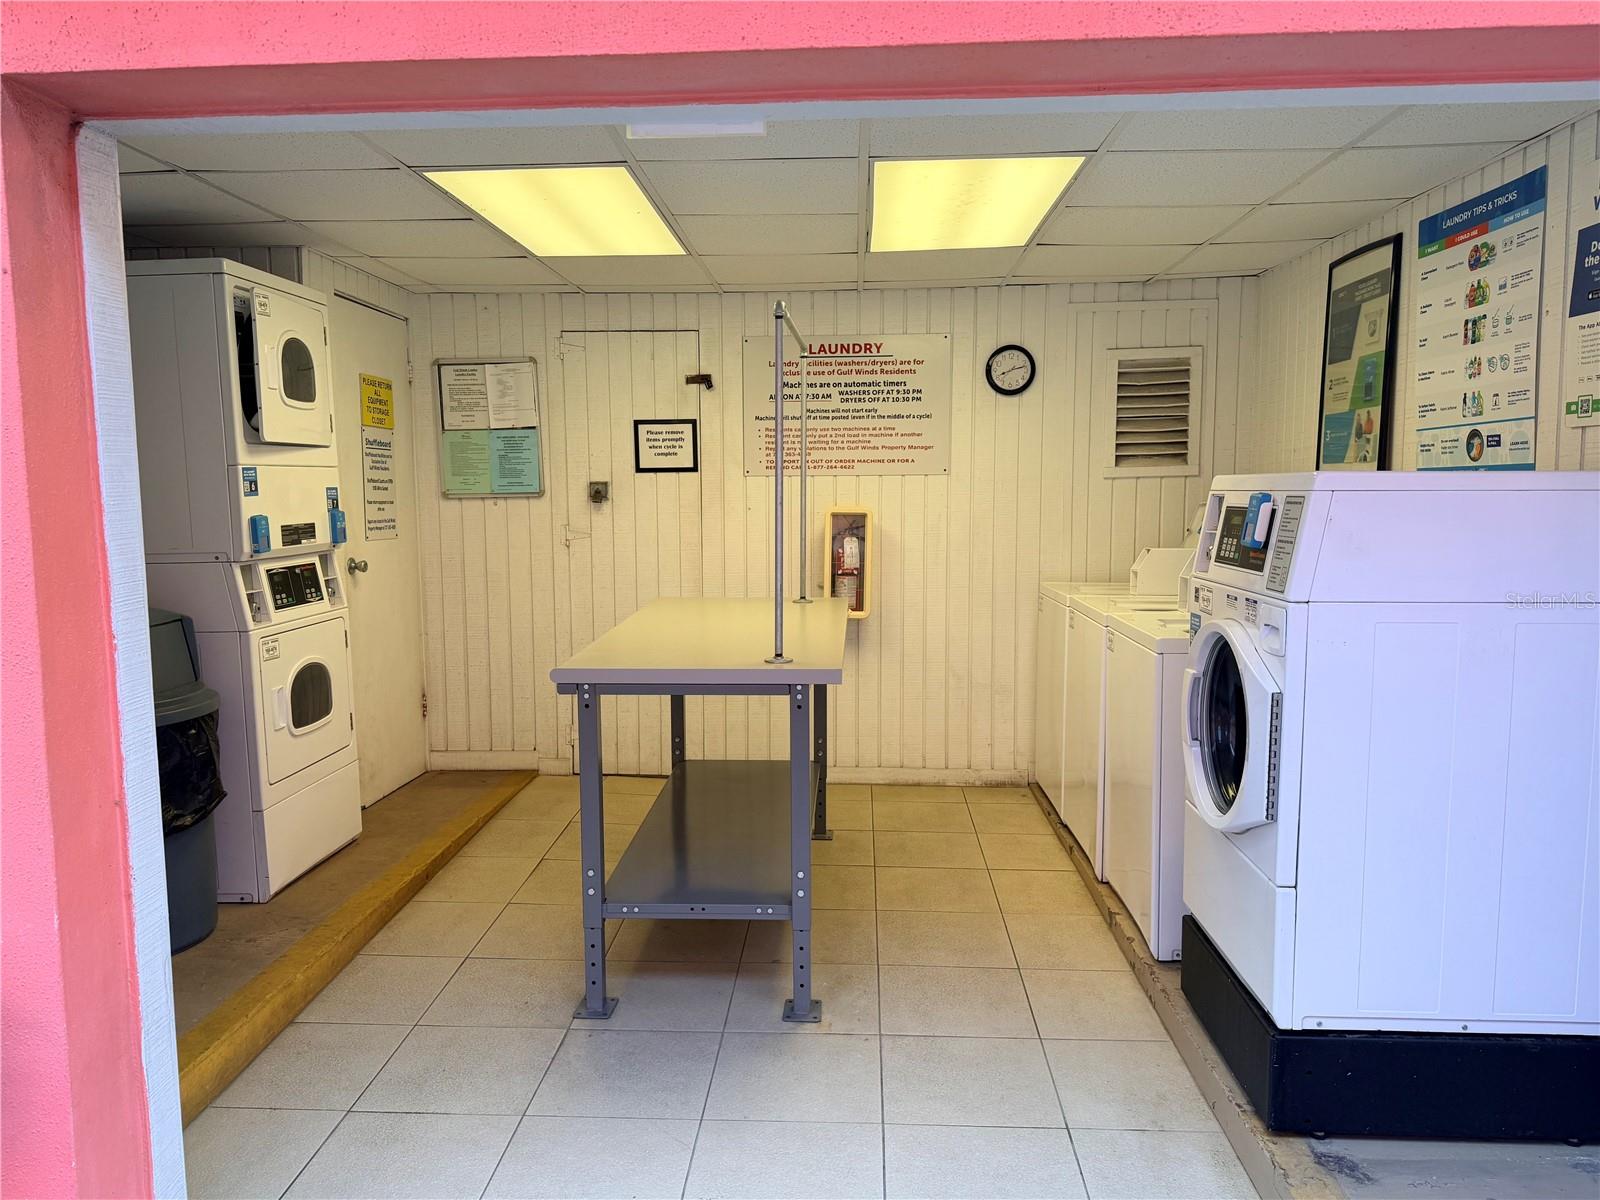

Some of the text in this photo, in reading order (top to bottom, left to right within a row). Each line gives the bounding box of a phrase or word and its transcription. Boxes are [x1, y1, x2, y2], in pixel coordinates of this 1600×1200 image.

[1442, 209, 1472, 229] LAUNDRY
[1473, 203, 1487, 216] TIPS
[1494, 190, 1518, 207] TRICKS
[1584, 254, 1599, 268] the
[809, 342, 884, 355] LAUNDRY
[835, 358, 898, 369] (washers/dryers)
[913, 358, 925, 366] for
[837, 368, 854, 376] Gulf
[855, 368, 878, 376] Winds
[880, 367, 917, 375] Residents
[843, 380, 882, 388] automatic
[806, 392, 820, 400] 7:30
[821, 392, 832, 400] AM
[838, 389, 870, 397] WASHERS
[865, 407, 878, 415] early
